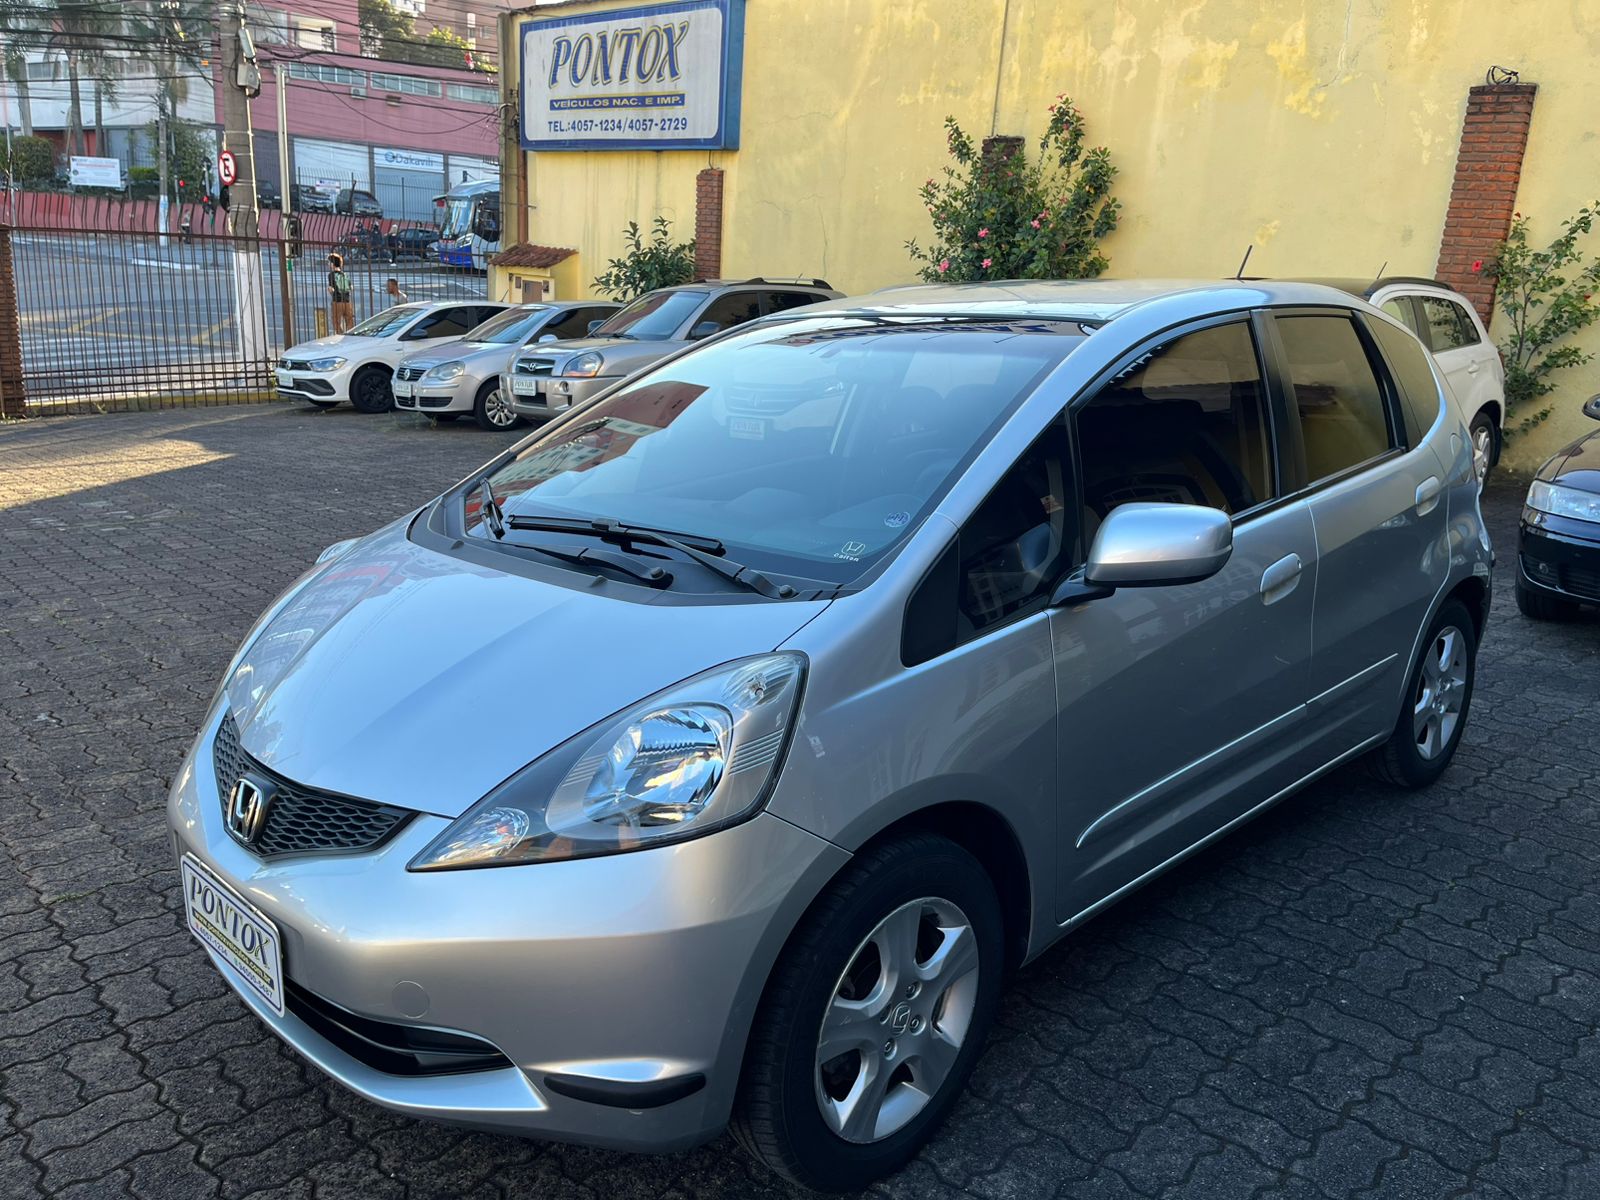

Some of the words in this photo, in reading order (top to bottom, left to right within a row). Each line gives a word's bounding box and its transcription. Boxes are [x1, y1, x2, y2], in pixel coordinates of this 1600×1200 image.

[549, 21, 689, 89] PONTOX
[612, 98, 641, 106] NAC.
[645, 97, 653, 105] E
[657, 96, 682, 104] IMP.
[190, 875, 270, 969] PONTOX
